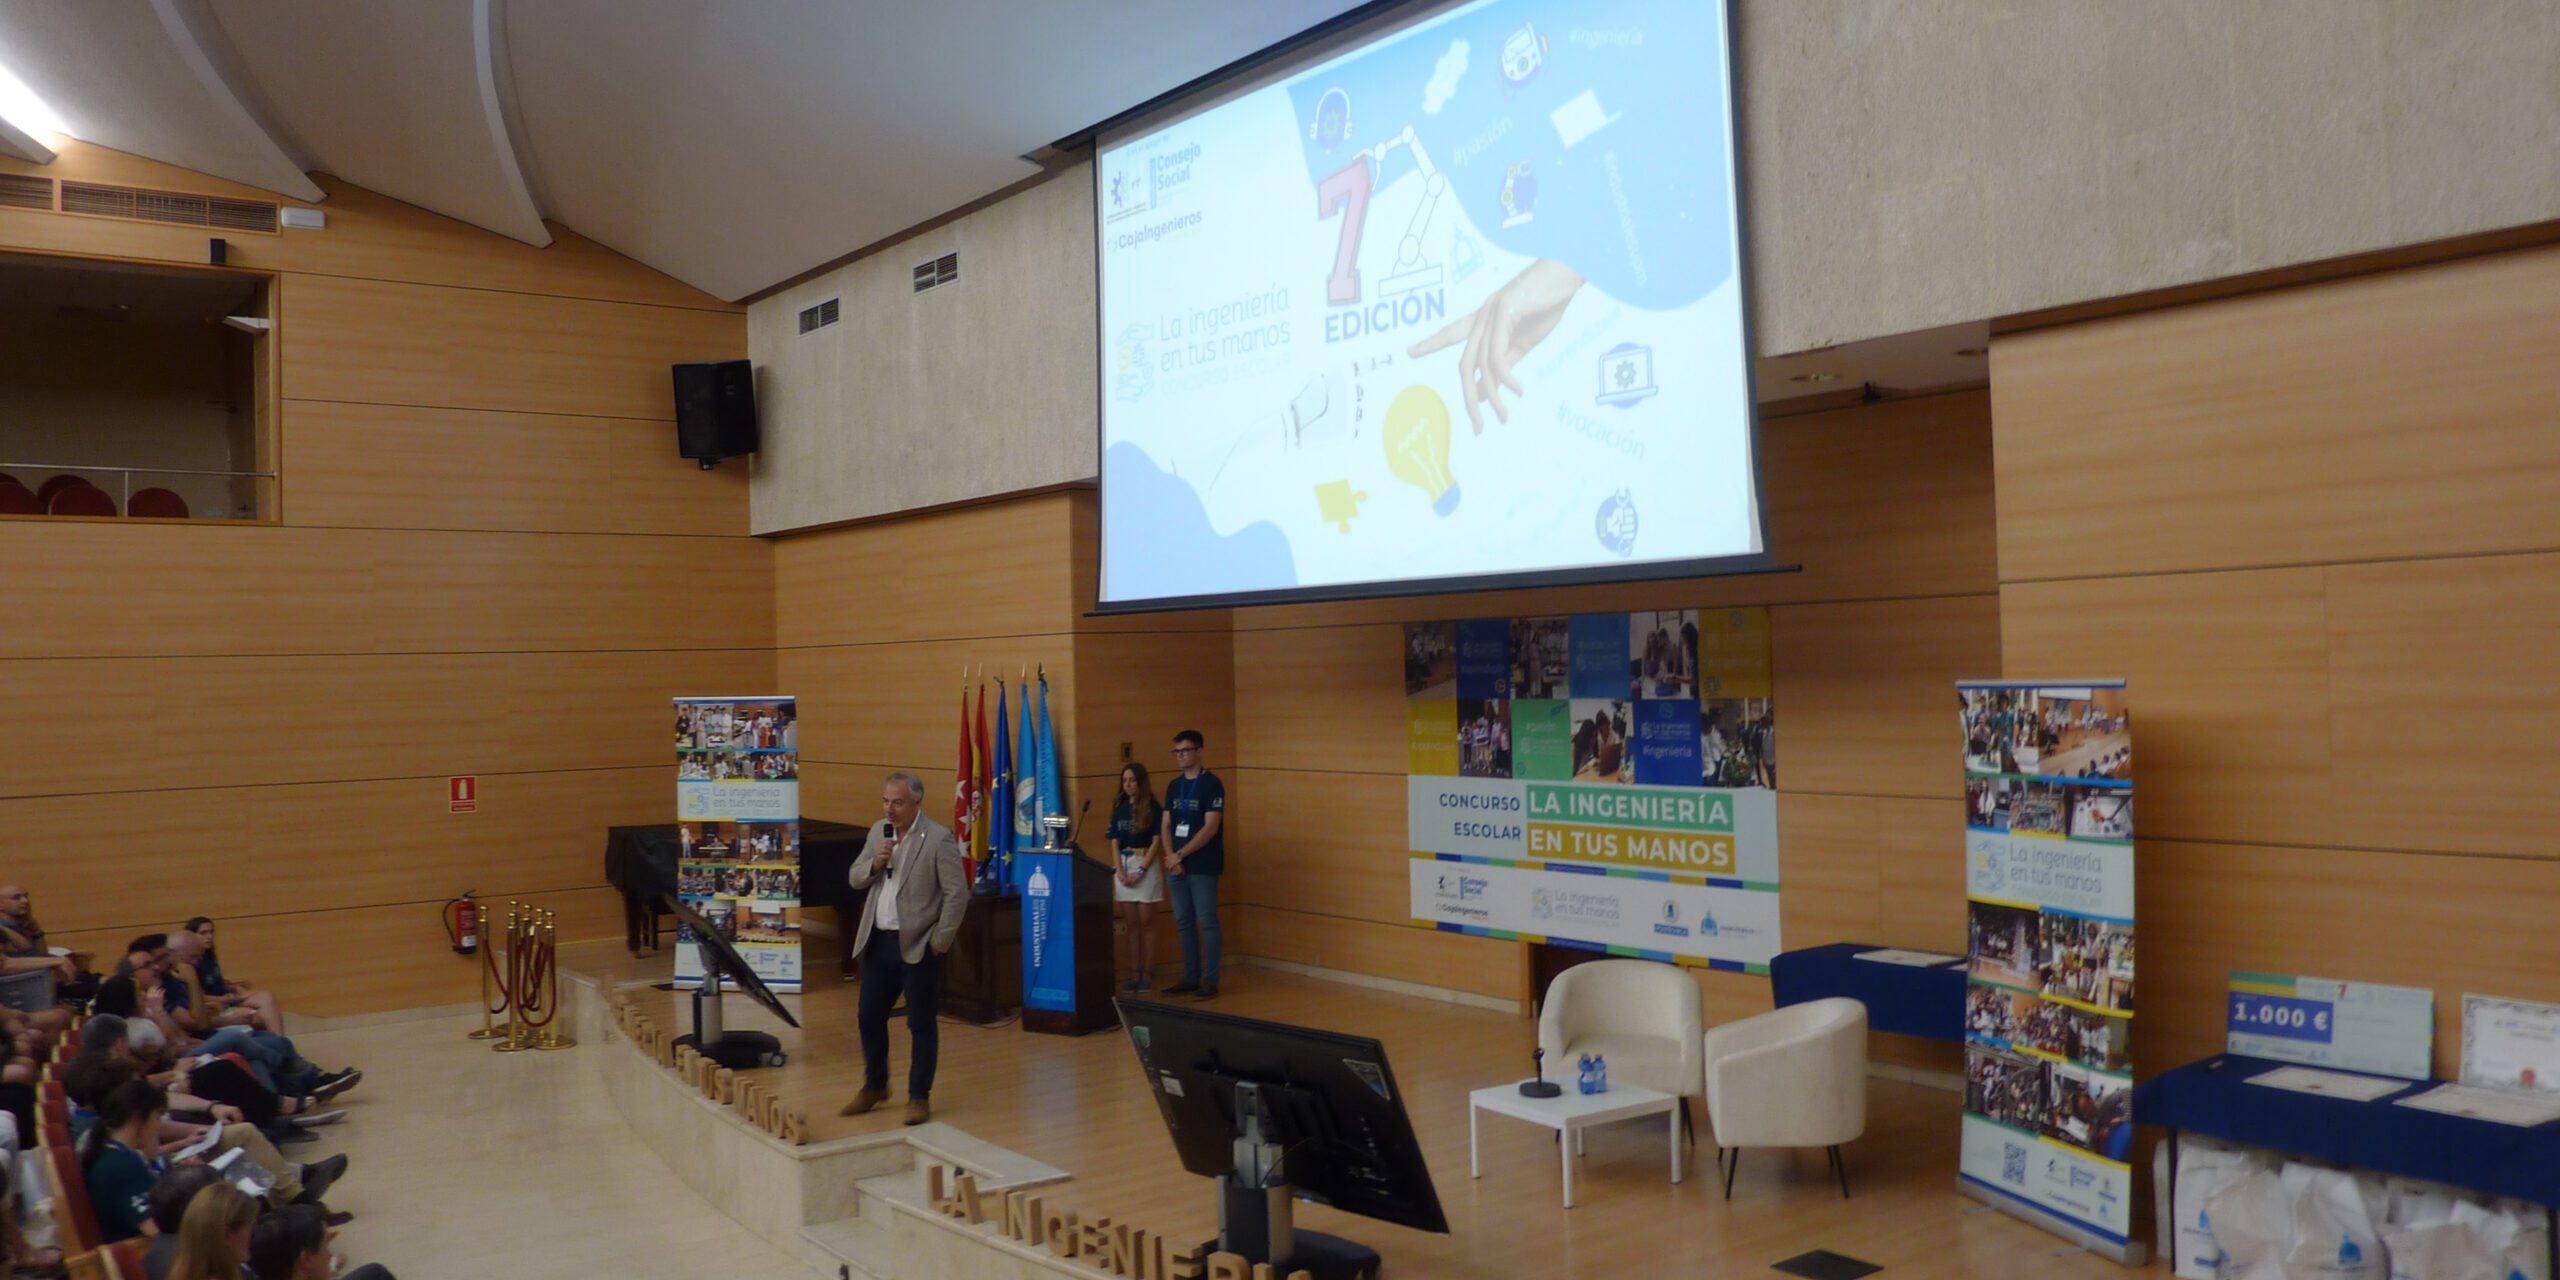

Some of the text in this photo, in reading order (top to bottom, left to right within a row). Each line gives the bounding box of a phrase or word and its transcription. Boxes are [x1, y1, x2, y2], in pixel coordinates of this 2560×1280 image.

[1156, 142, 1202, 172] Consejo
[1157, 164, 1191, 191] Social
[1317, 153, 1374, 307] 7
[1160, 282, 1290, 343] La ingeniería
[1325, 286, 1445, 345] EDICIÓN
[1160, 320, 1292, 373] en tus manos
[1556, 400, 1647, 460] #vocación
[1439, 791, 1730, 826] CONCURSO LA INGENIERÍA
[1454, 821, 1729, 867] ESCOLAR EN TUS MANOS
[2010, 844, 2102, 873] La ingeniería
[2010, 866, 2102, 894] en tus manos
[1554, 889, 1620, 908] La ingeniería
[1555, 903, 1620, 921] en tus manos
[2234, 1002, 2306, 1028] 1.000
[2313, 1011, 2328, 1031] €
[926, 1163, 983, 1225] LA
